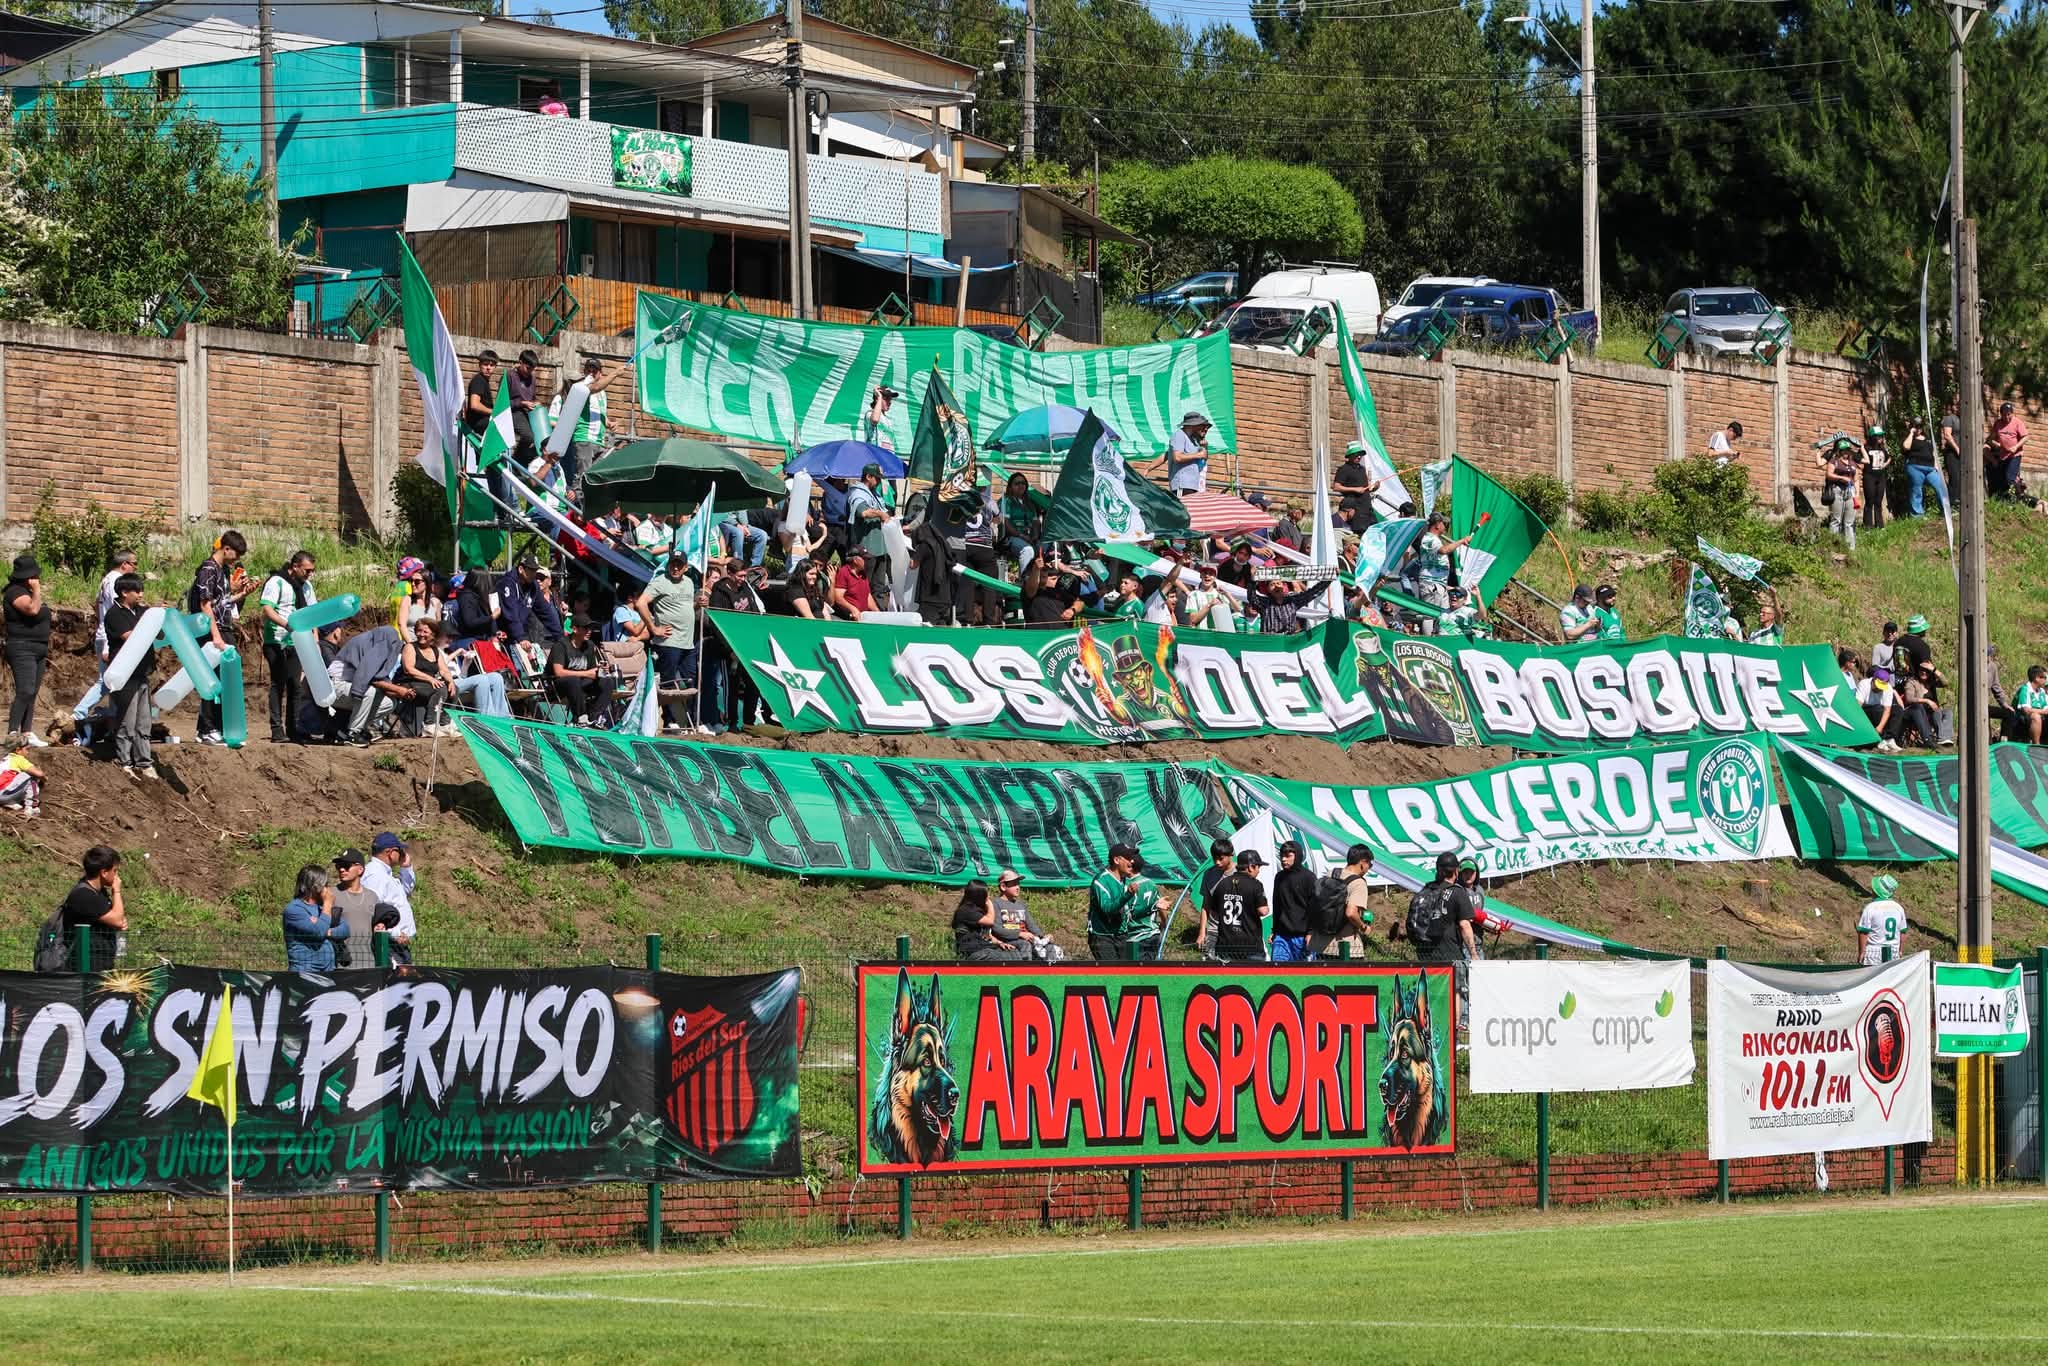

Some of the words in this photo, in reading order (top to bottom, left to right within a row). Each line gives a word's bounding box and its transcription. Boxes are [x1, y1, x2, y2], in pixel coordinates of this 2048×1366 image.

[1396, 645, 1411, 657] LOS
[1412, 645, 1425, 657] DEL
[781, 670, 814, 692] 82
[824, 637, 1067, 728] LOS
[1176, 643, 1375, 732] DEL
[1458, 650, 1809, 737] BOSQUE
[1808, 691, 1828, 708] 85
[1703, 759, 1717, 783] CLUB
[1716, 747, 1746, 763] DEPORTES
[460, 716, 846, 868] YUMBEL
[1312, 750, 1694, 858] ALBIVERDE
[1495, 846, 1531, 871] QUE
[1223, 900, 1243, 925] 32
[1885, 917, 1897, 941] 9
[1776, 1009, 1822, 1027] RADIO
[1939, 995, 2001, 1023] CHILLÁN
[696, 1029, 716, 1062] del
[720, 1020, 746, 1047] Sur
[1485, 1017, 1557, 1055] cmpc
[1592, 1016, 1654, 1053] cmpc
[1742, 1029, 1854, 1057] RINCONADA
[299, 981, 615, 1126] PERMISO
[962, 985, 1179, 1150] ARAYA
[1181, 984, 1379, 1145] SPORT
[1760, 1058, 1826, 1111] 101.1
[1826, 1074, 1851, 1104] FM
[17, 1134, 148, 1191] AMIGOS
[156, 1128, 268, 1180] UNIDOS
[277, 1125, 337, 1176] POR
[346, 1119, 384, 1170] LA
[394, 1115, 482, 1163] MISMA
